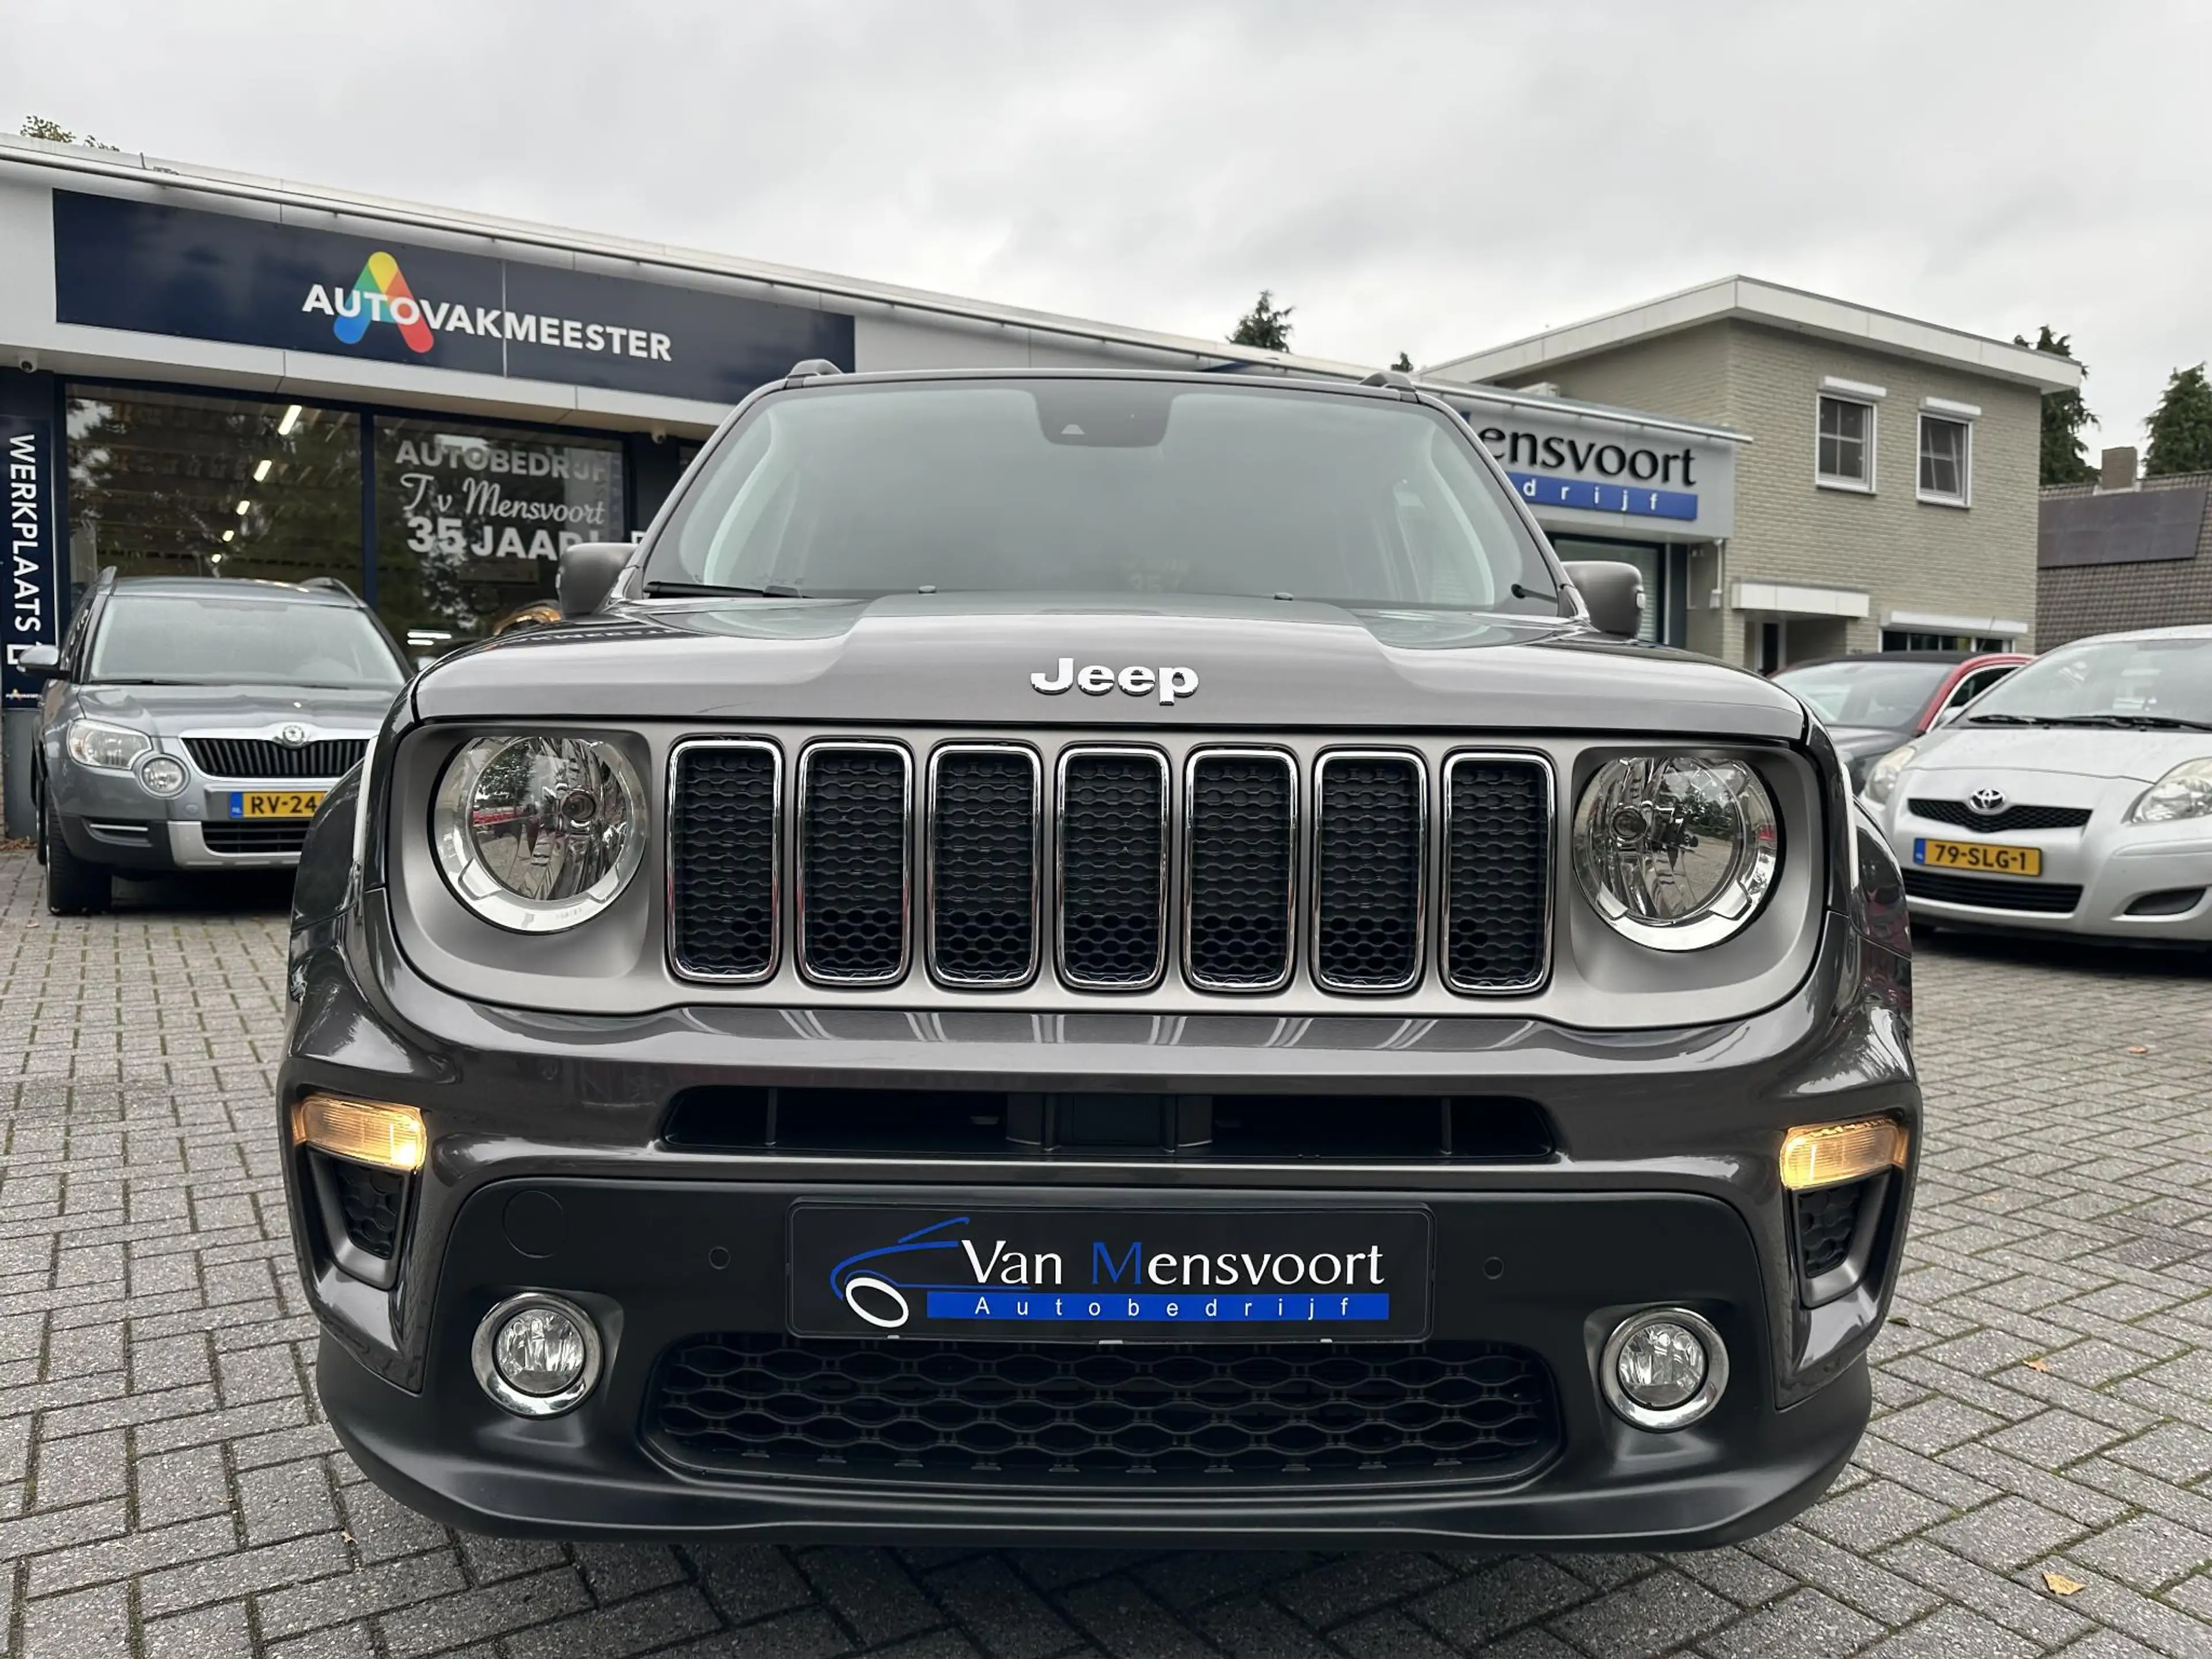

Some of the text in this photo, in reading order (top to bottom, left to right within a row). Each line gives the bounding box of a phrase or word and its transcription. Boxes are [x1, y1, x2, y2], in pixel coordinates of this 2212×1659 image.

[302, 284, 672, 362] AUTOVAKMEESTER
[1459, 411, 1697, 487] ensvoort
[463, 477, 605, 525] Mensvoort
[9, 434, 42, 632] WERKPLAATS
[407, 516, 466, 559] 35
[1031, 657, 1199, 706] Jeep
[1934, 844, 2025, 870] 79-SLG-1
[961, 1240, 1385, 1285] Van Mensvoort
